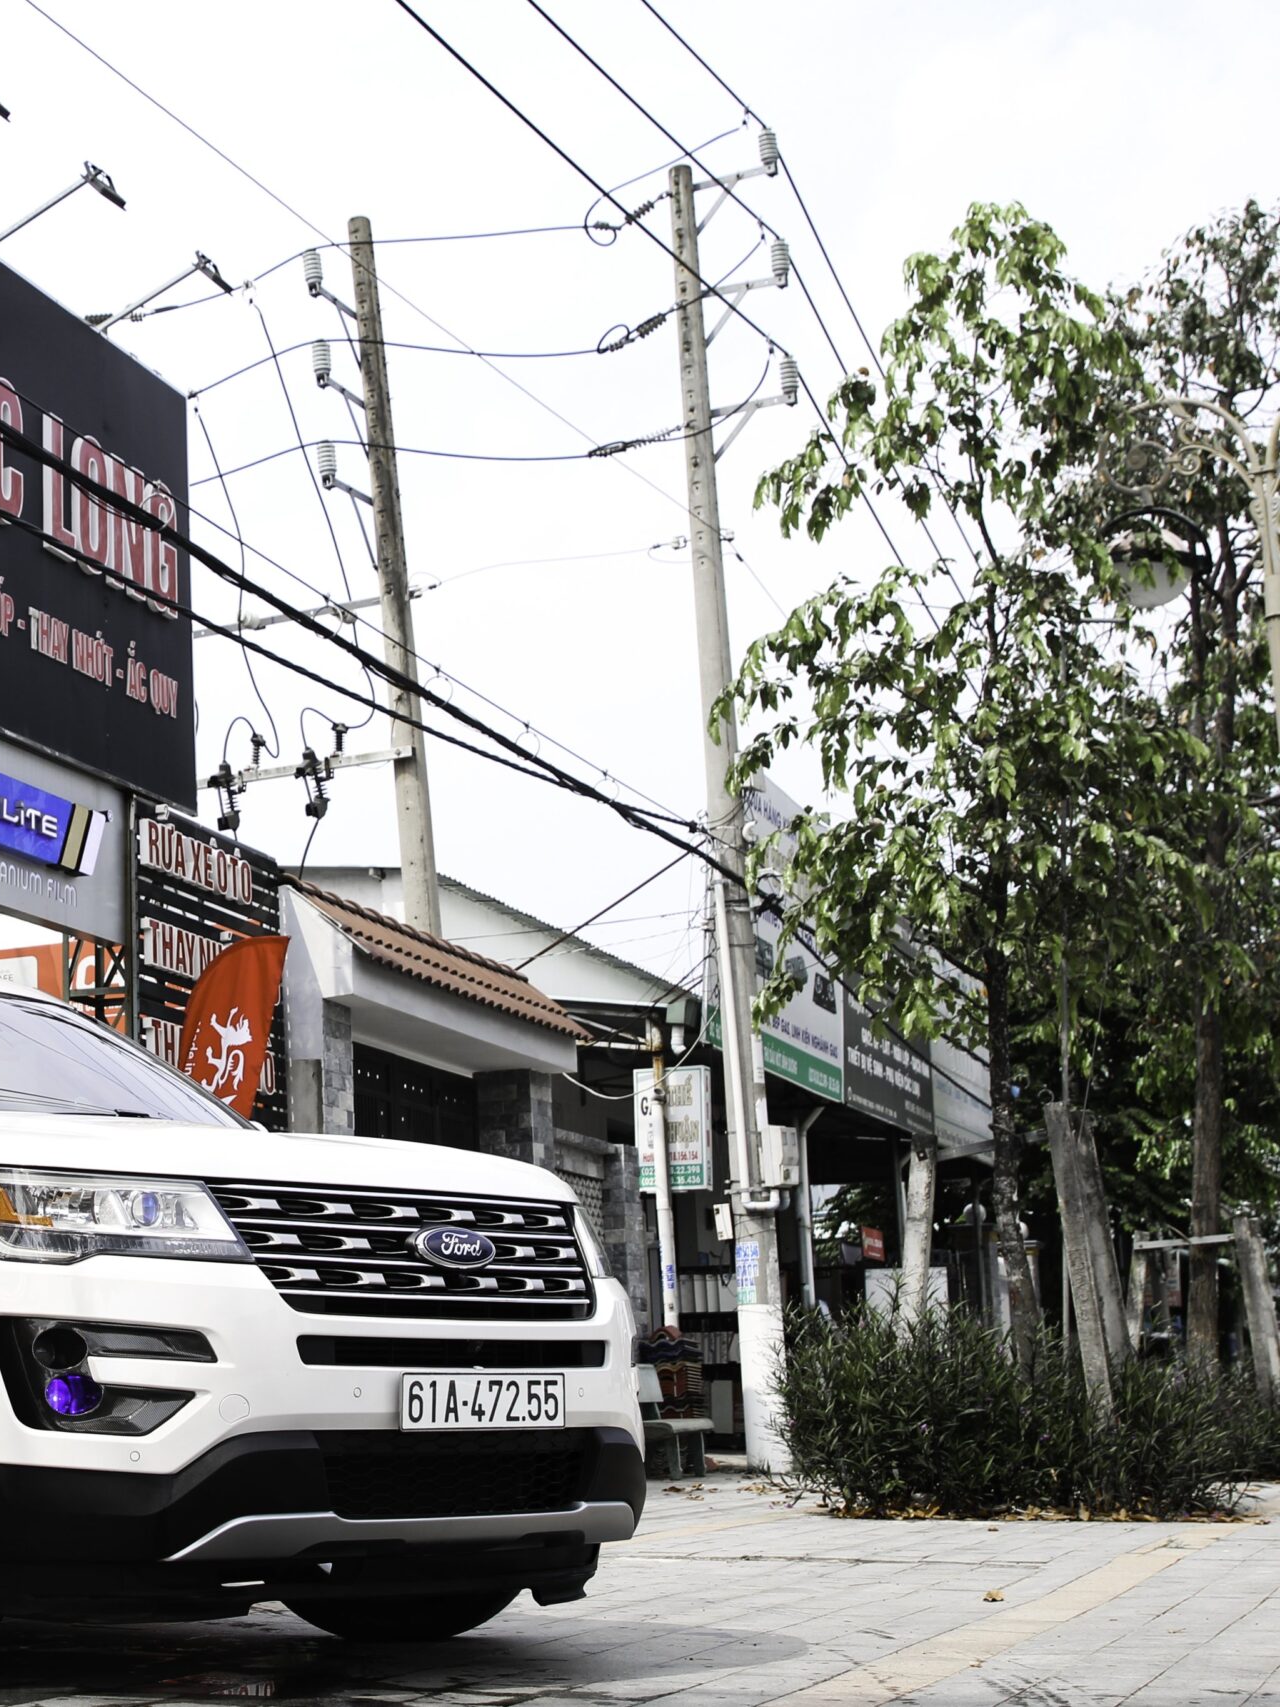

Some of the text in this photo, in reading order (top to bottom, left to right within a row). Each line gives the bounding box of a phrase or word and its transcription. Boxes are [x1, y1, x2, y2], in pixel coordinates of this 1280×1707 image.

[42, 412, 178, 619] LONG
[28, 606, 69, 665] THAY
[72, 628, 114, 687] NHỚT
[149, 668, 179, 719] QUY
[187, 838, 215, 891] XE
[46, 878, 78, 907] FILM
[141, 915, 196, 981] THAY
[668, 1115, 699, 1149] HUẬN
[441, 1231, 483, 1257] Ford
[407, 1380, 560, 1424] 61A-472.55
